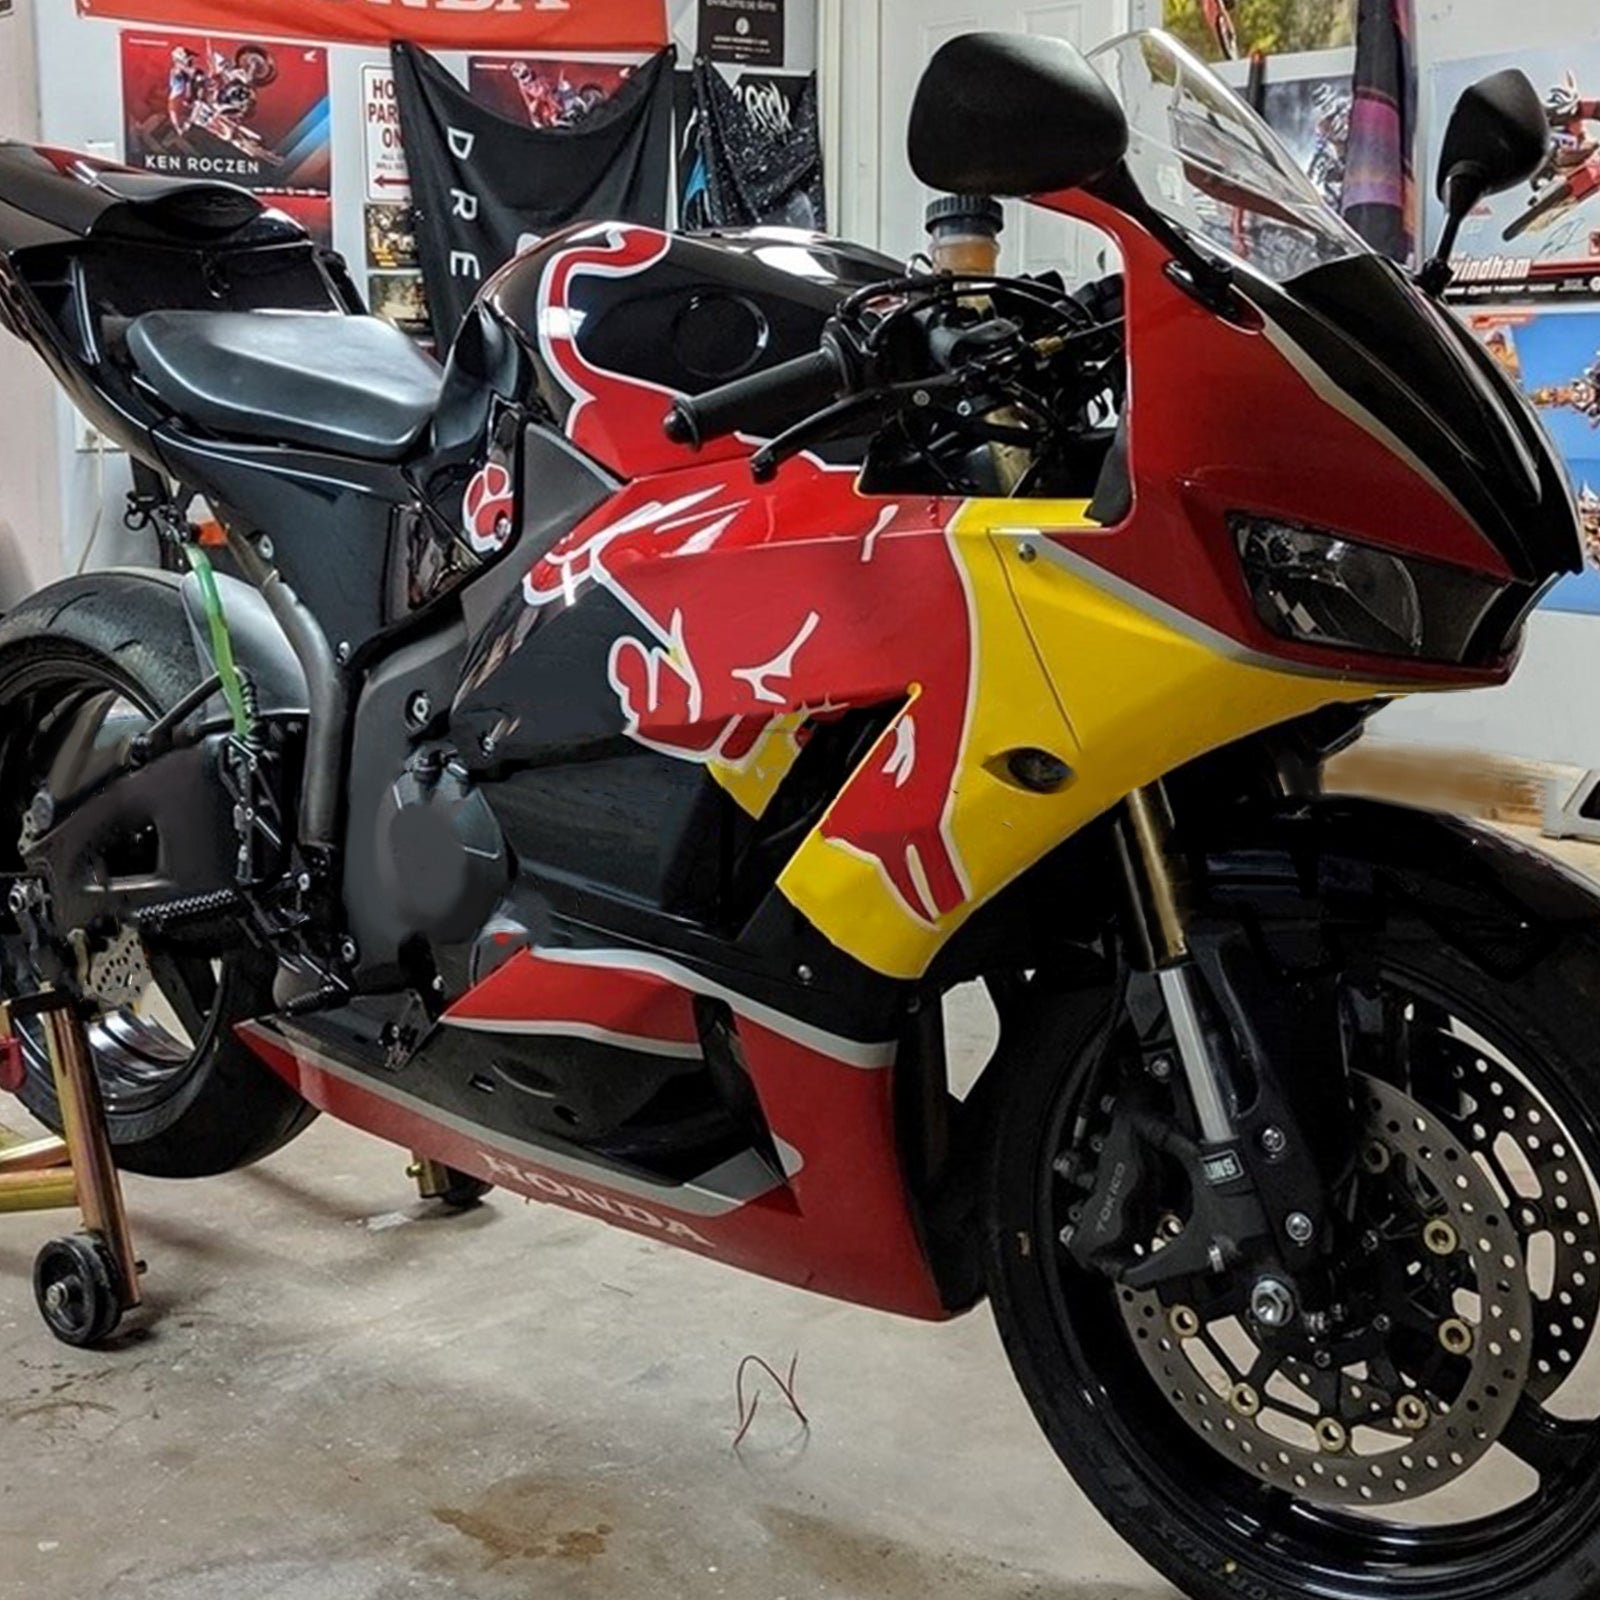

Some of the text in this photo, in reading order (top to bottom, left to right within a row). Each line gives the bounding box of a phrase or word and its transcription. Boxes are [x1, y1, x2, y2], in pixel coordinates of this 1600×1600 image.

[372, 79, 398, 100] HO
[368, 102, 399, 123] PAR
[382, 127, 405, 148] ON
[145, 154, 259, 174] KEN ROCZEN
[477, 1151, 716, 1247] HONDA
[1095, 1161, 1126, 1232] TOKICO
